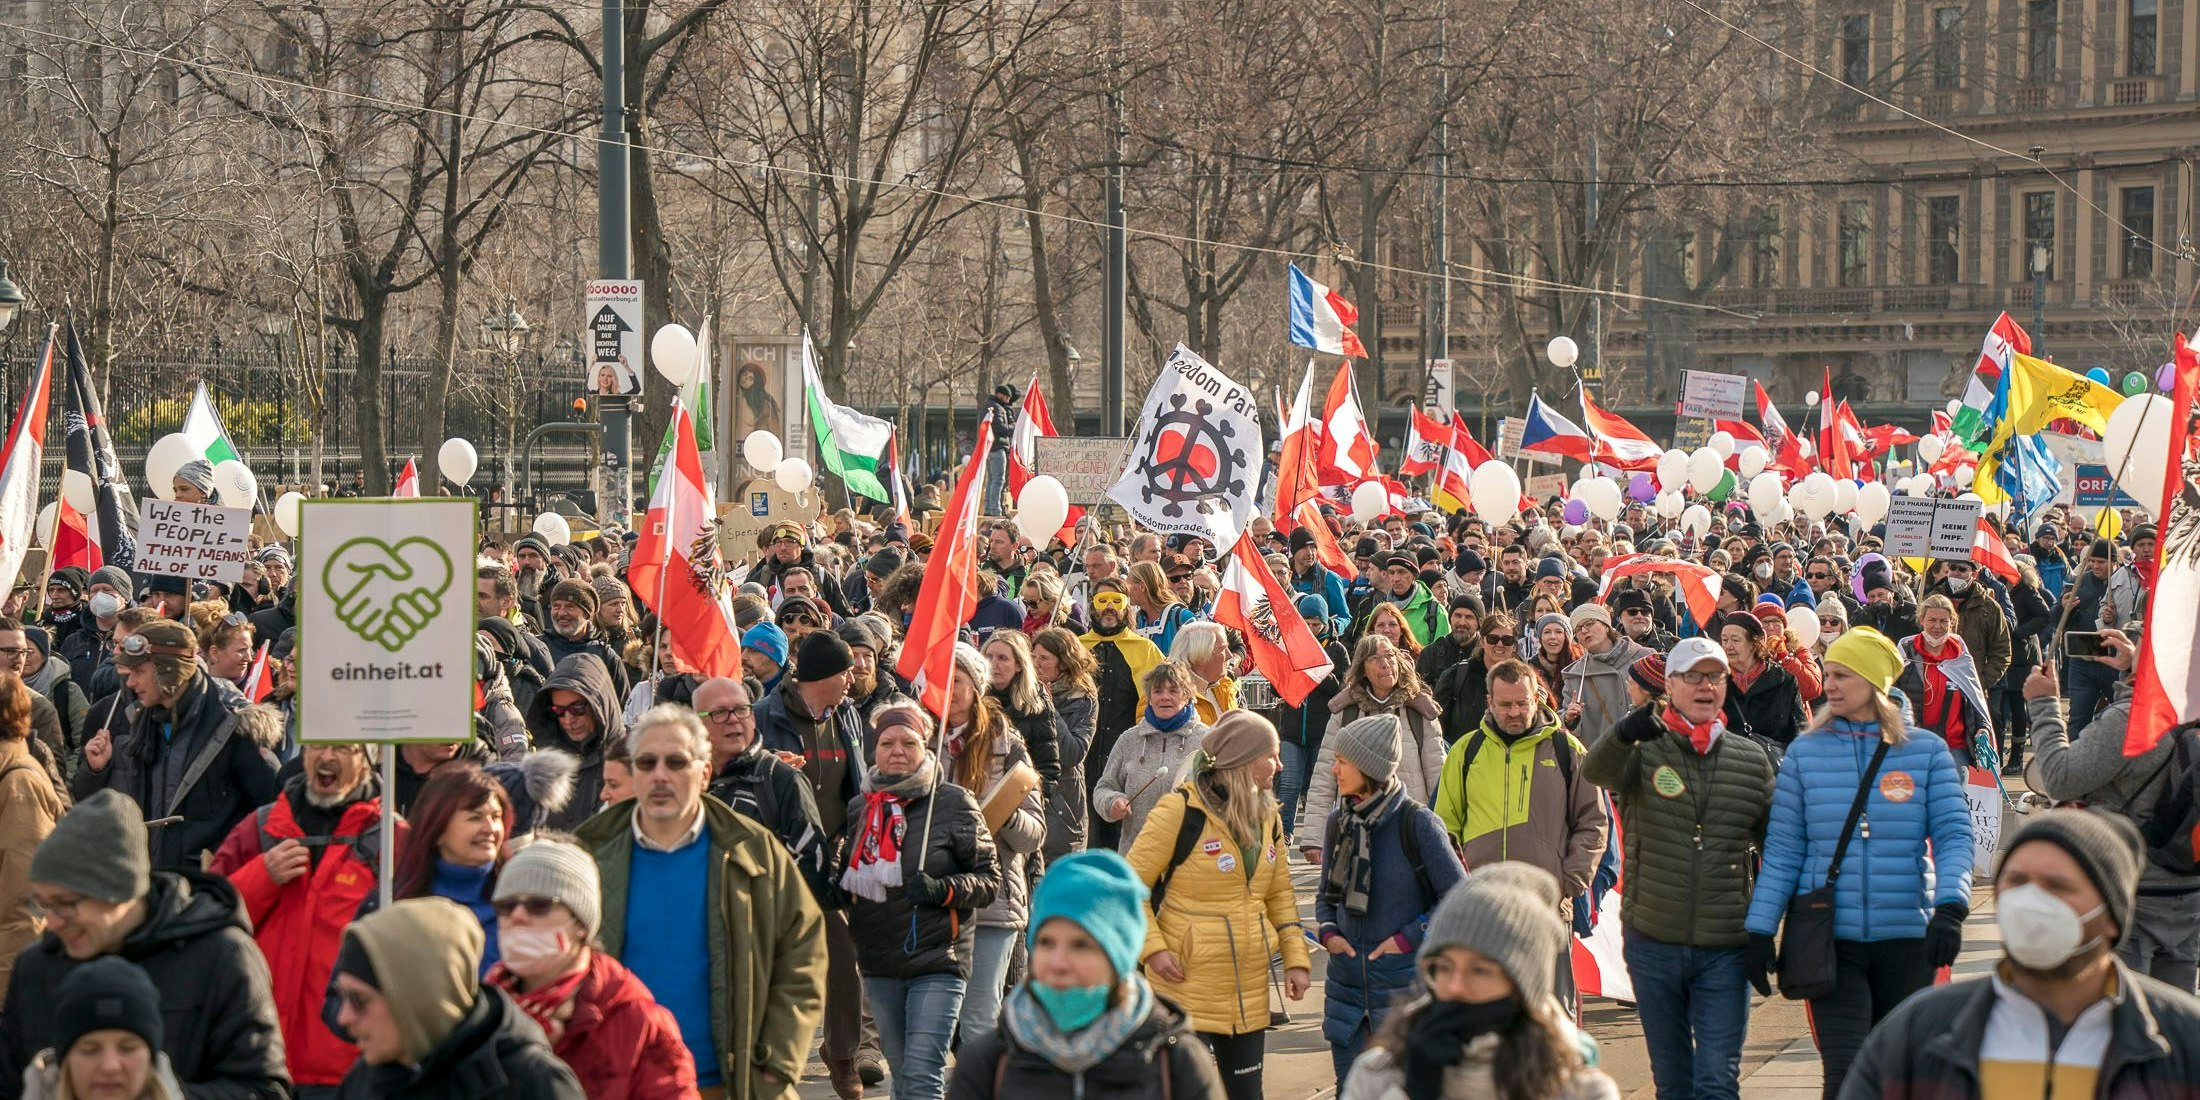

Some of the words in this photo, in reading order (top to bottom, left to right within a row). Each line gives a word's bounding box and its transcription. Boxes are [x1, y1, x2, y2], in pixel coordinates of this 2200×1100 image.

[598, 314, 616, 323] AUF
[597, 348, 617, 358] WEG
[1936, 503, 1974, 511] FREIHEIT
[150, 504, 181, 522] We
[192, 507, 225, 525] the
[1891, 509, 1933, 517] GENTECHNIK
[1132, 506, 1216, 540] freedomparade.de
[1942, 523, 1968, 531] KEINE
[1940, 533, 1964, 541] IMPF-
[146, 543, 196, 559] THAT
[197, 548, 246, 563] MEANS
[1930, 545, 1970, 554] DIKTATUR
[137, 558, 162, 572] ALL
[169, 562, 189, 574] OF
[199, 564, 218, 577] US
[331, 662, 443, 680] einheit.at
